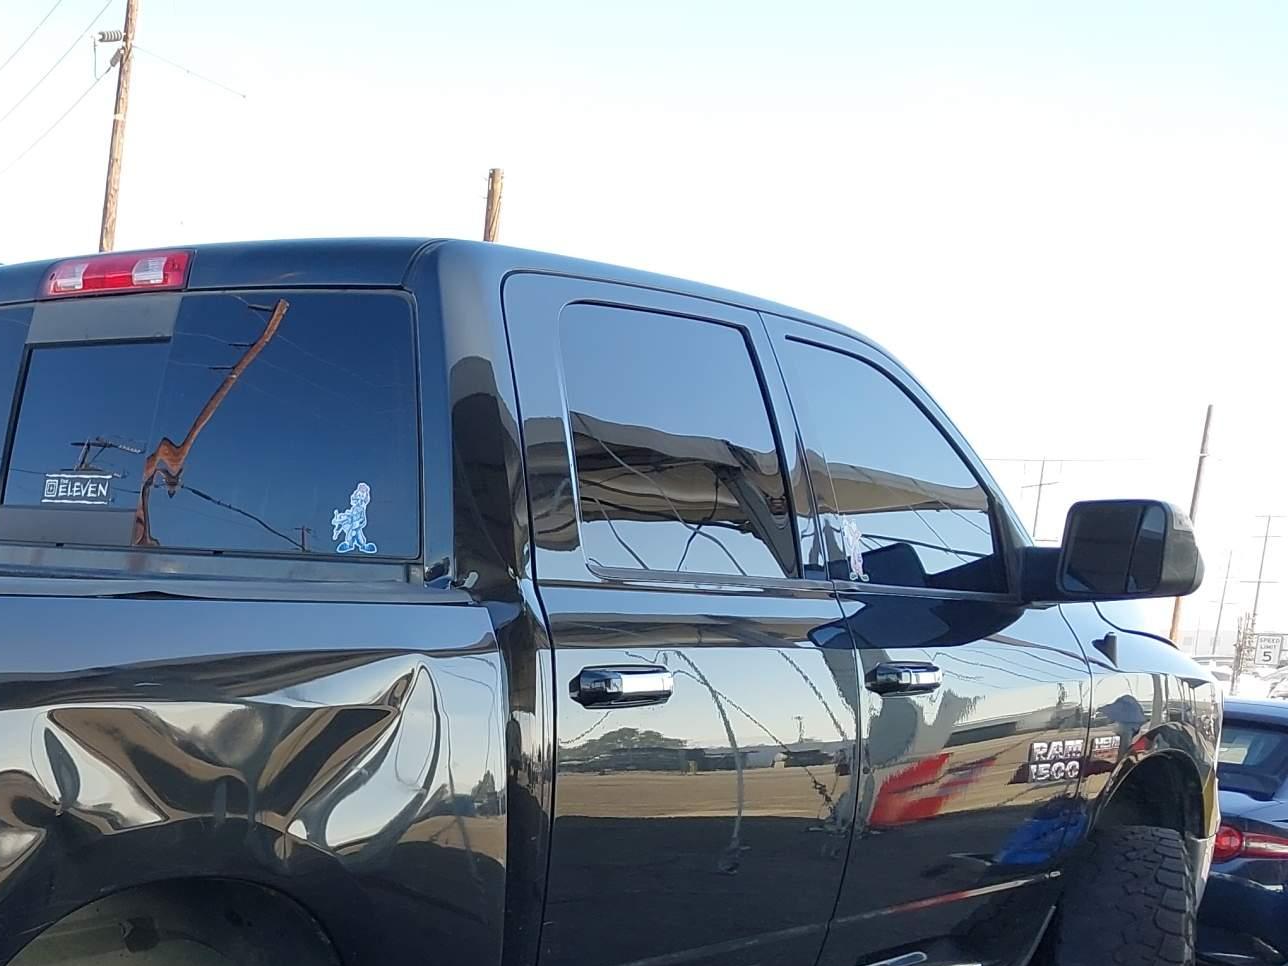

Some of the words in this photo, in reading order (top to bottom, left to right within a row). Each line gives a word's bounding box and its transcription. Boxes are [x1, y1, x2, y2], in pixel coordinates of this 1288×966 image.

[58, 479, 109, 497] ELEVEN
[1262, 651, 1272, 662] 5
[1032, 739, 1083, 761] RAM
[1030, 760, 1080, 780] 1500
